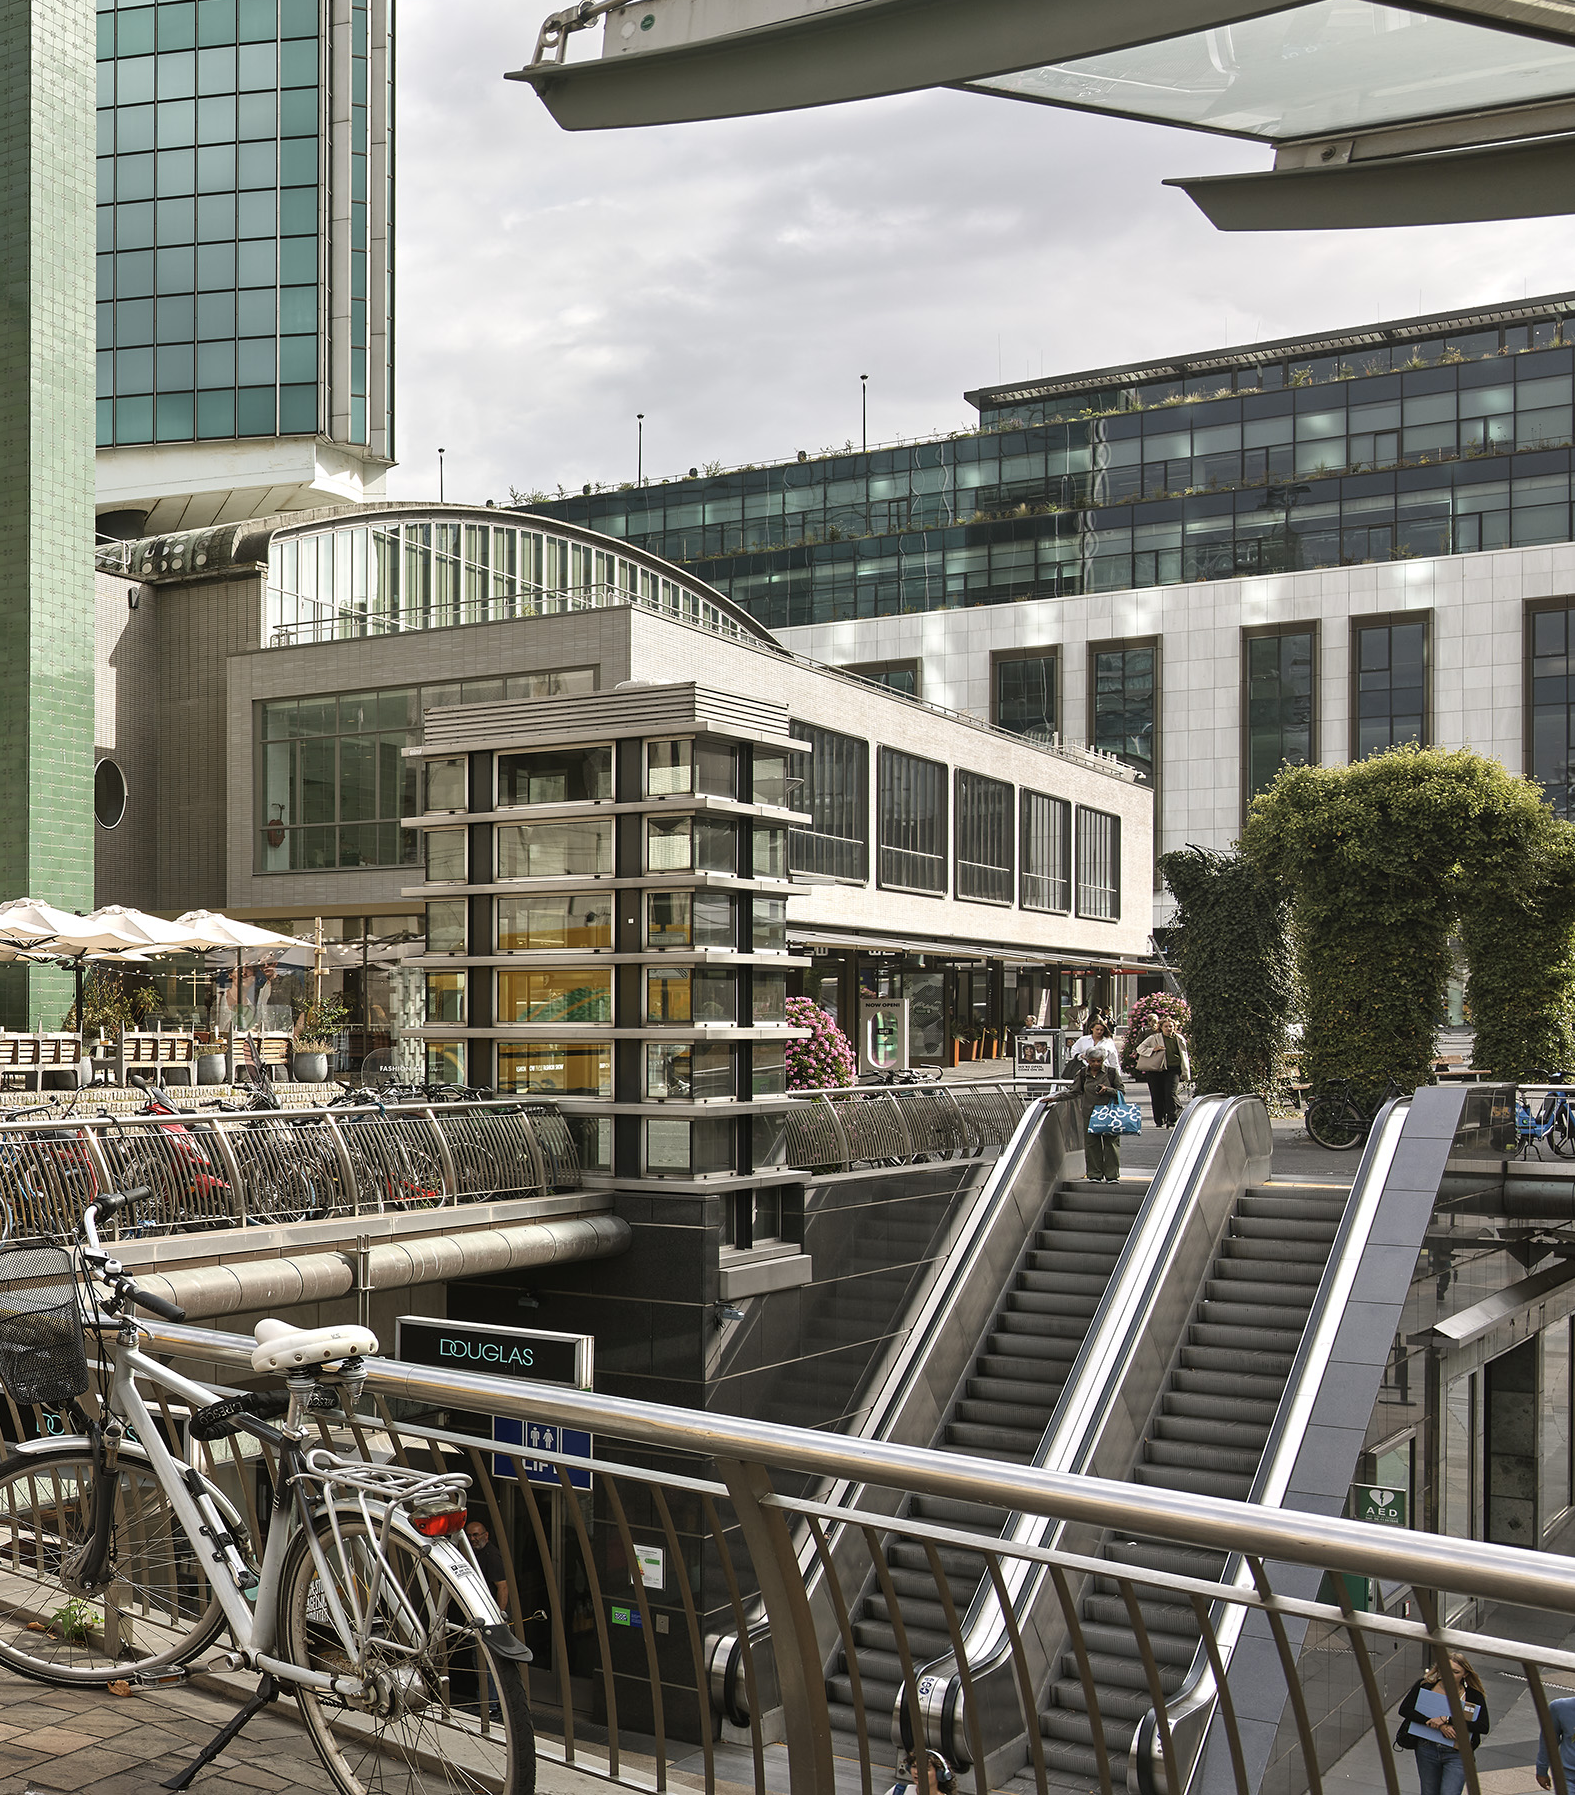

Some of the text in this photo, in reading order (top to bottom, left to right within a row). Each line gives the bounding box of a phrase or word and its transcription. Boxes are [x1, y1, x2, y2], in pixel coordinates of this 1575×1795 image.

[440, 1338, 534, 1367] DOUGLAS
[199, 1401, 244, 1425] DRESCO
[1366, 1506, 1398, 1517] AED
